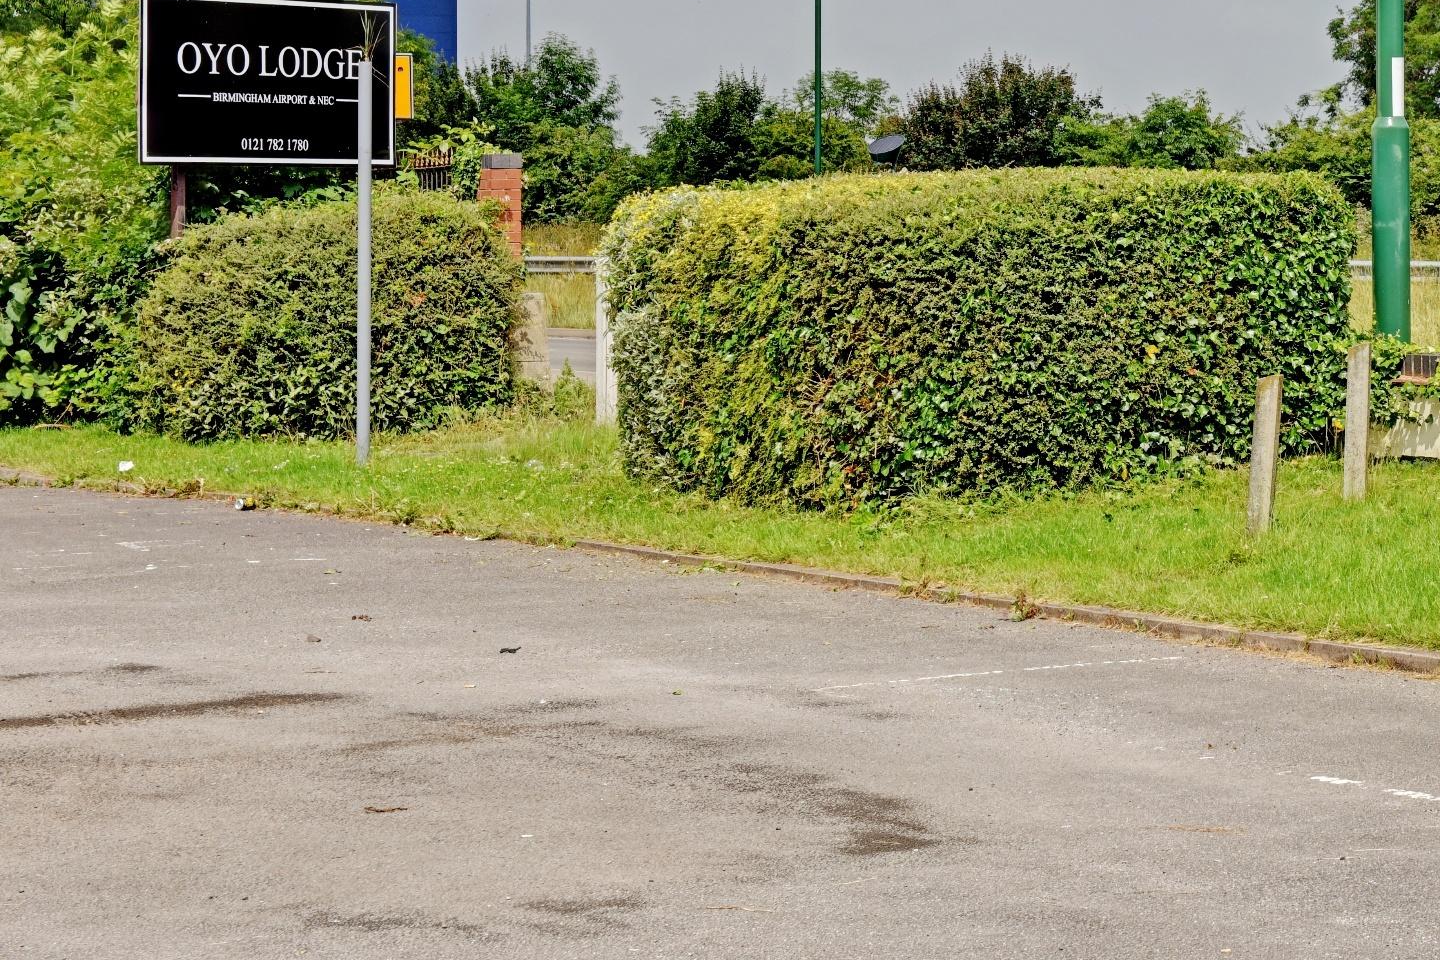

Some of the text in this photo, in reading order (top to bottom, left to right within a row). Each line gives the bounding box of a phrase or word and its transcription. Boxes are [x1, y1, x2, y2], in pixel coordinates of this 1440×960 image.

[177, 41, 363, 80] OYO LODGE
[212, 92, 335, 106] BIRMINGHAM AIRPORT & NEC
[241, 137, 309, 152] 0121 782 1780
